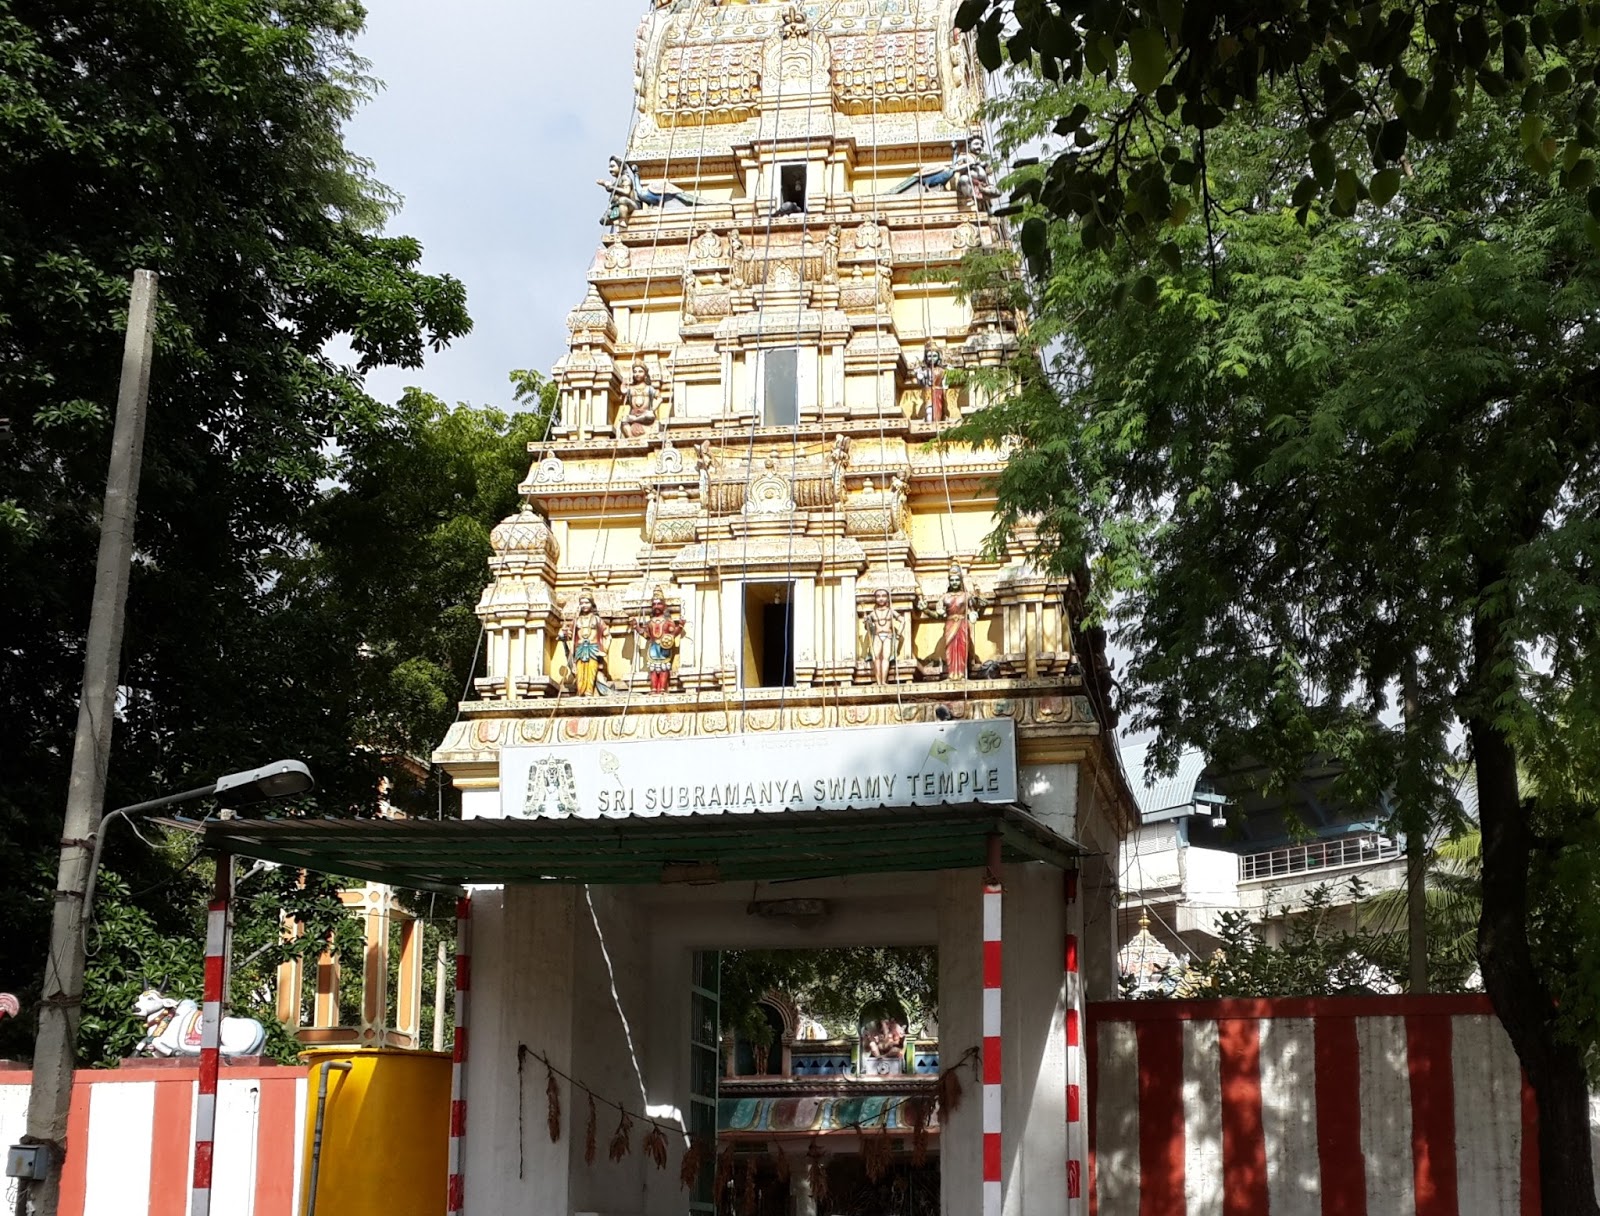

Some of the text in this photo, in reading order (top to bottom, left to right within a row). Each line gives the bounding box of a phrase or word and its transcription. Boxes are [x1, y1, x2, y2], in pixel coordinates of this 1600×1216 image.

[598, 768, 999, 812] SRI SUBRAMANYA SWAMY TEMPLE
